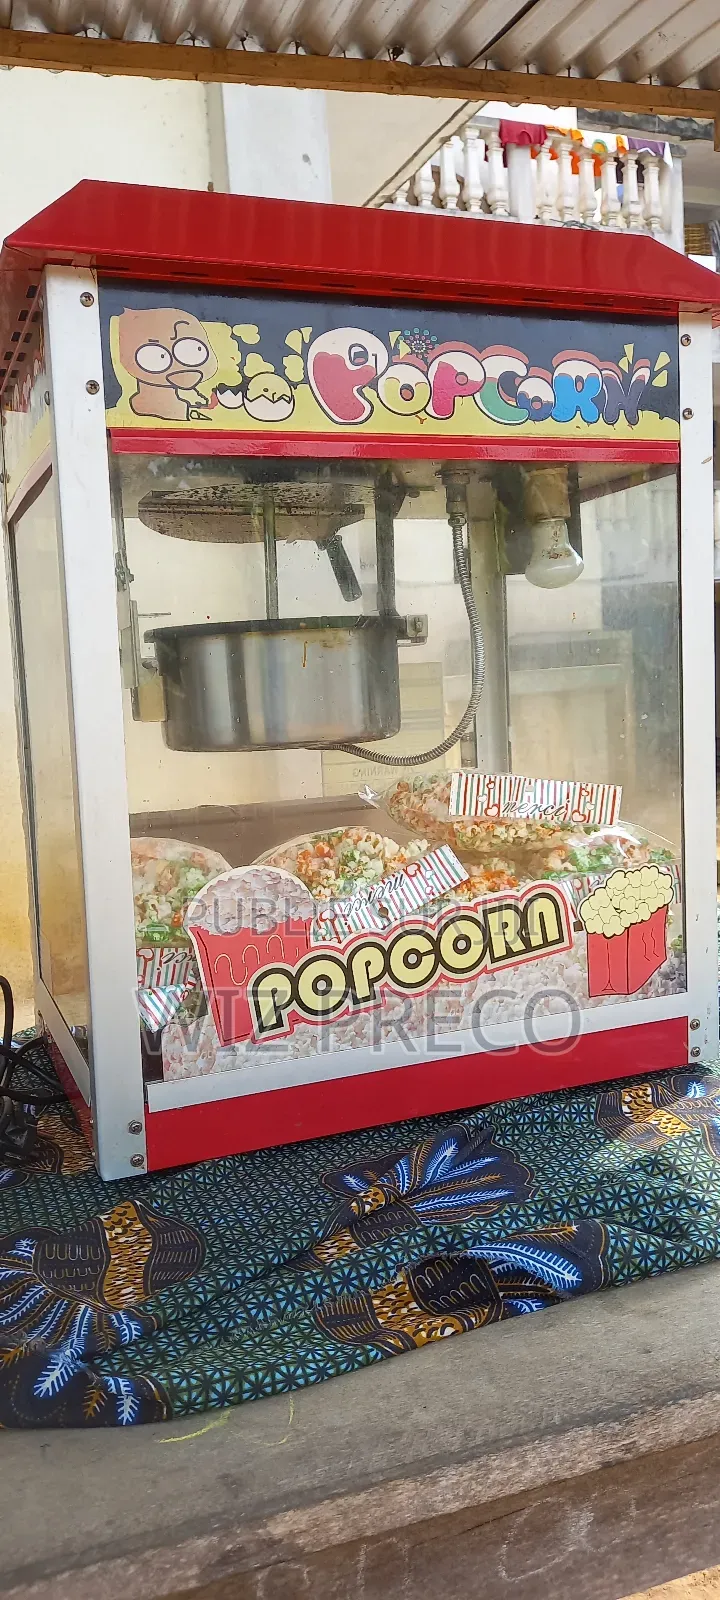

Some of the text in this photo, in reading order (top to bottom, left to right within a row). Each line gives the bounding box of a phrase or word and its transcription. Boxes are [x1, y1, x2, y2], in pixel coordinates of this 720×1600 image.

[501, 797, 571, 817] merci
[343, 873, 405, 925] merci
[250, 890, 566, 1035] POPCORN
